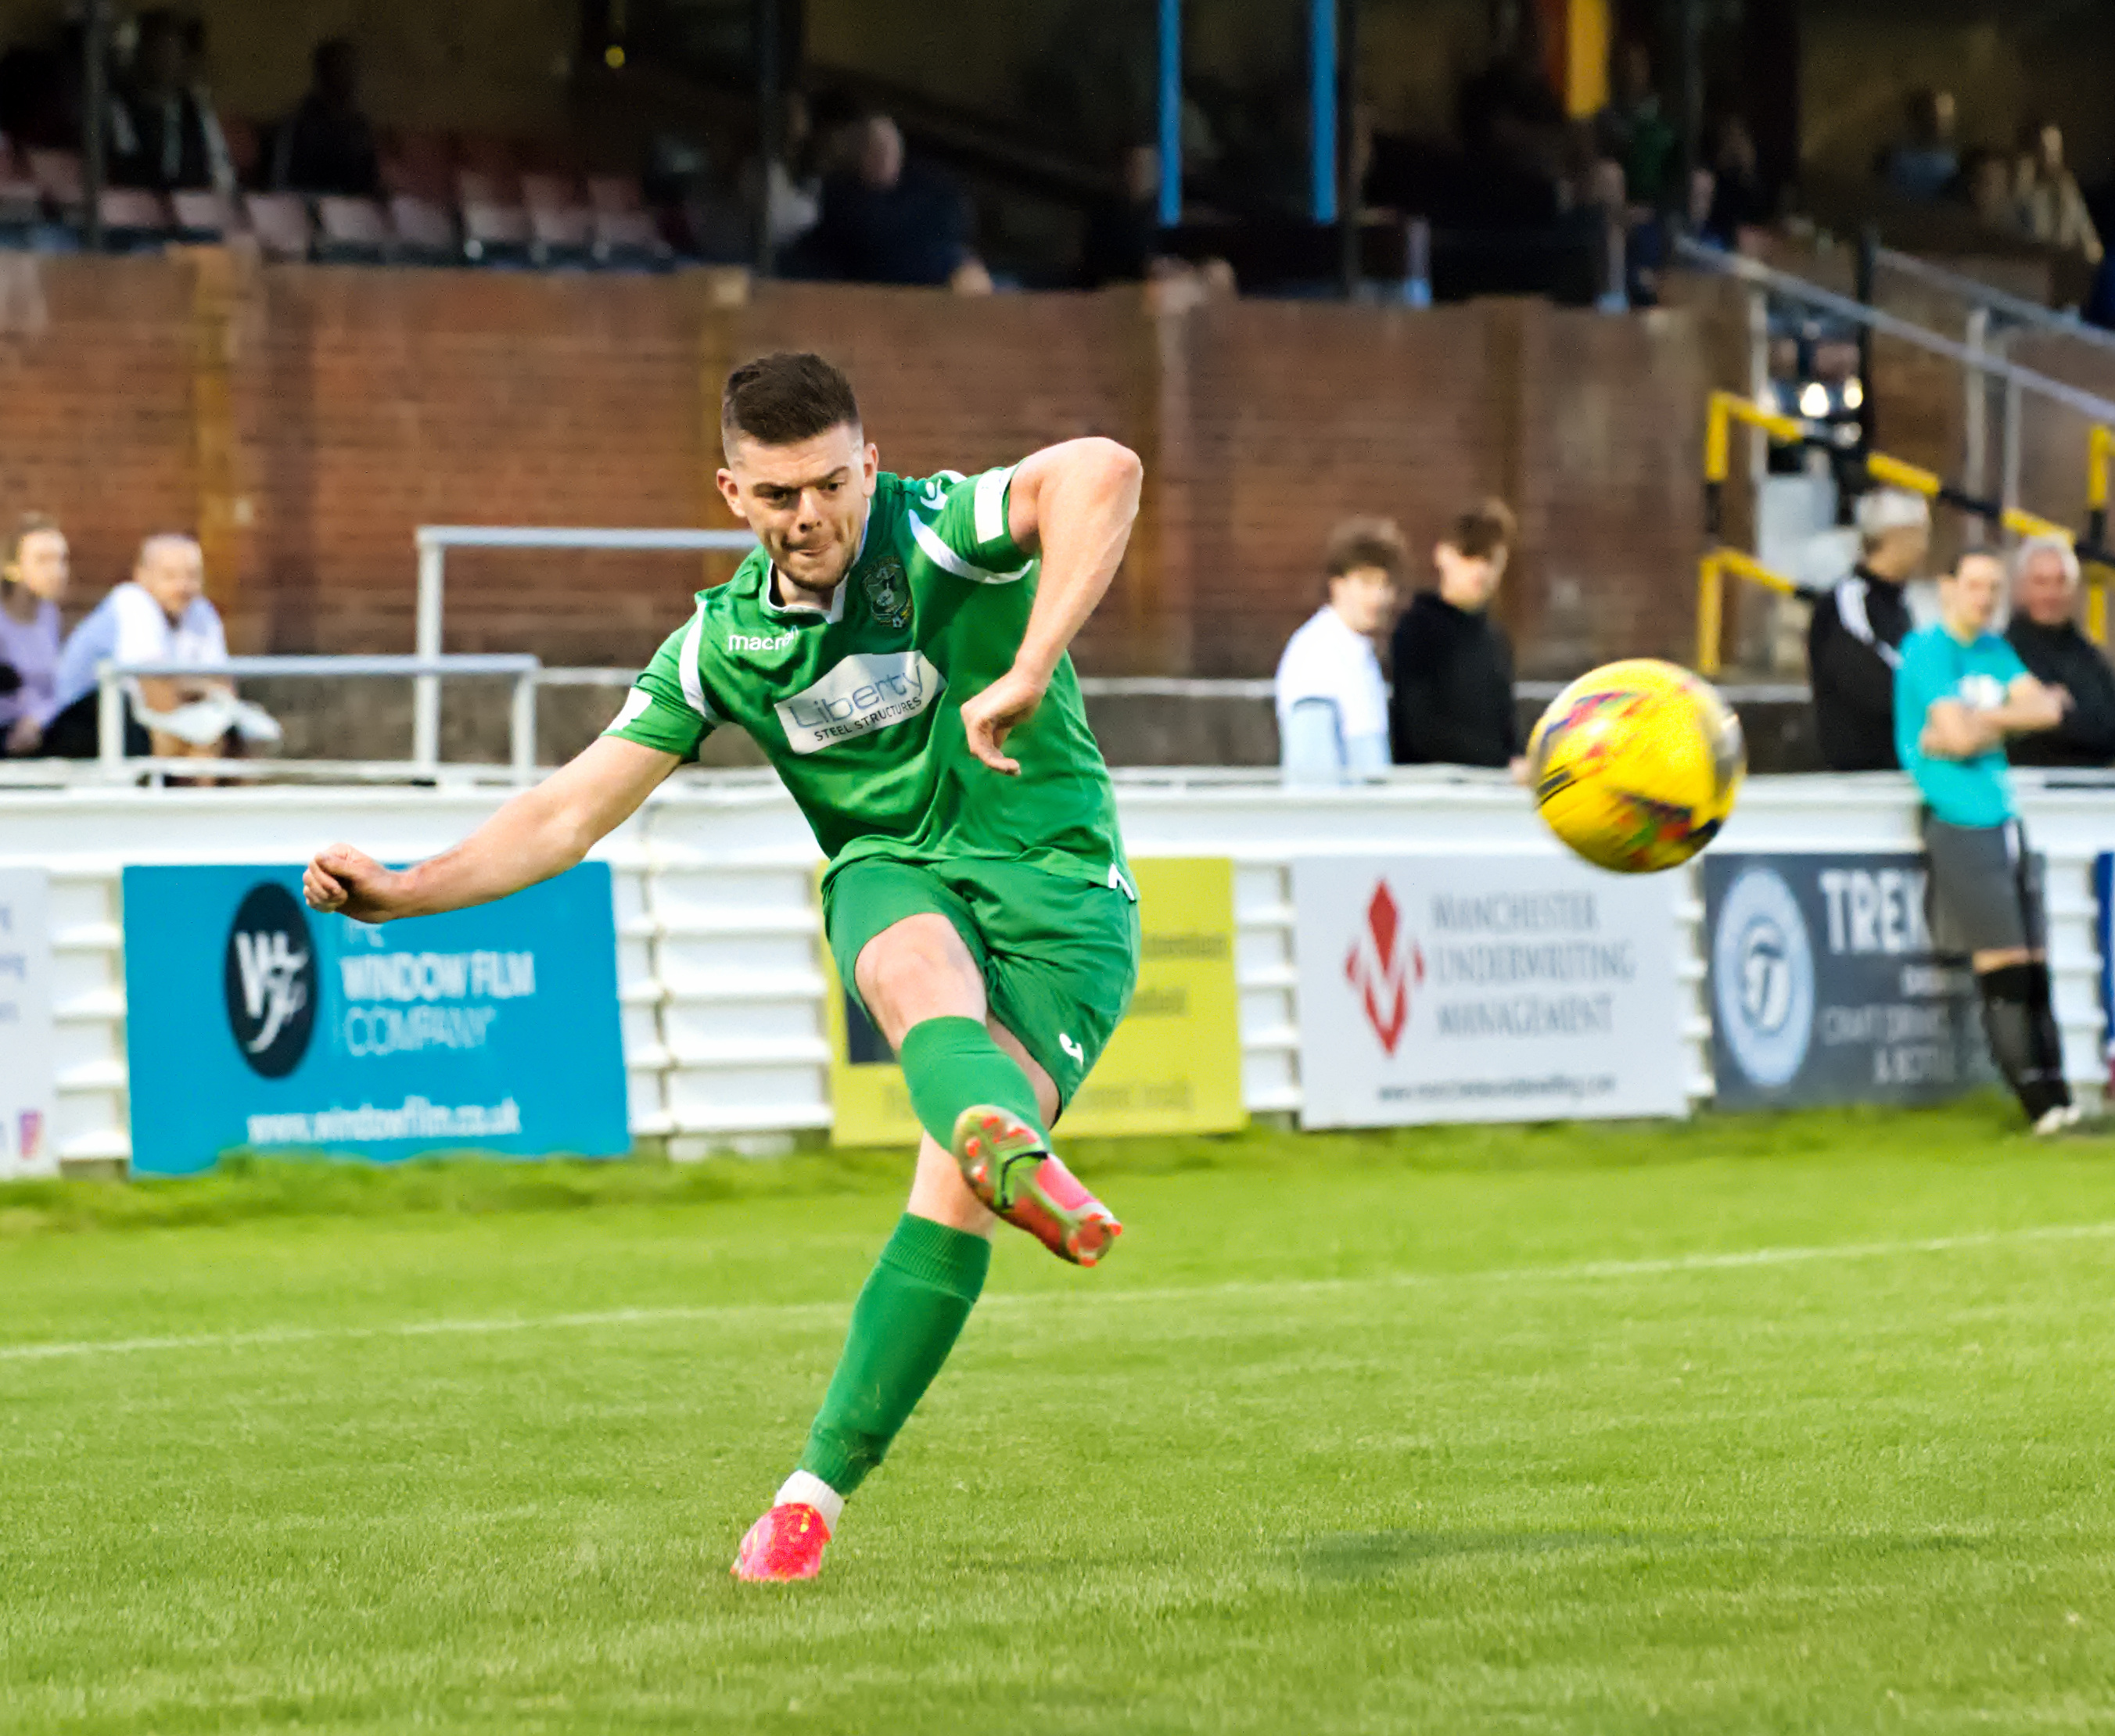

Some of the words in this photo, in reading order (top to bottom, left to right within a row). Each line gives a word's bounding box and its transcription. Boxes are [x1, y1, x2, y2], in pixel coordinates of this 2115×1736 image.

[789, 665, 923, 728] Liberty
[814, 725, 853, 742] STEEL
[854, 696, 921, 730] STRUCTURES
[340, 952, 469, 1001] WINDOW
[471, 950, 536, 999] FILM
[345, 1005, 497, 1056] COMPANY
